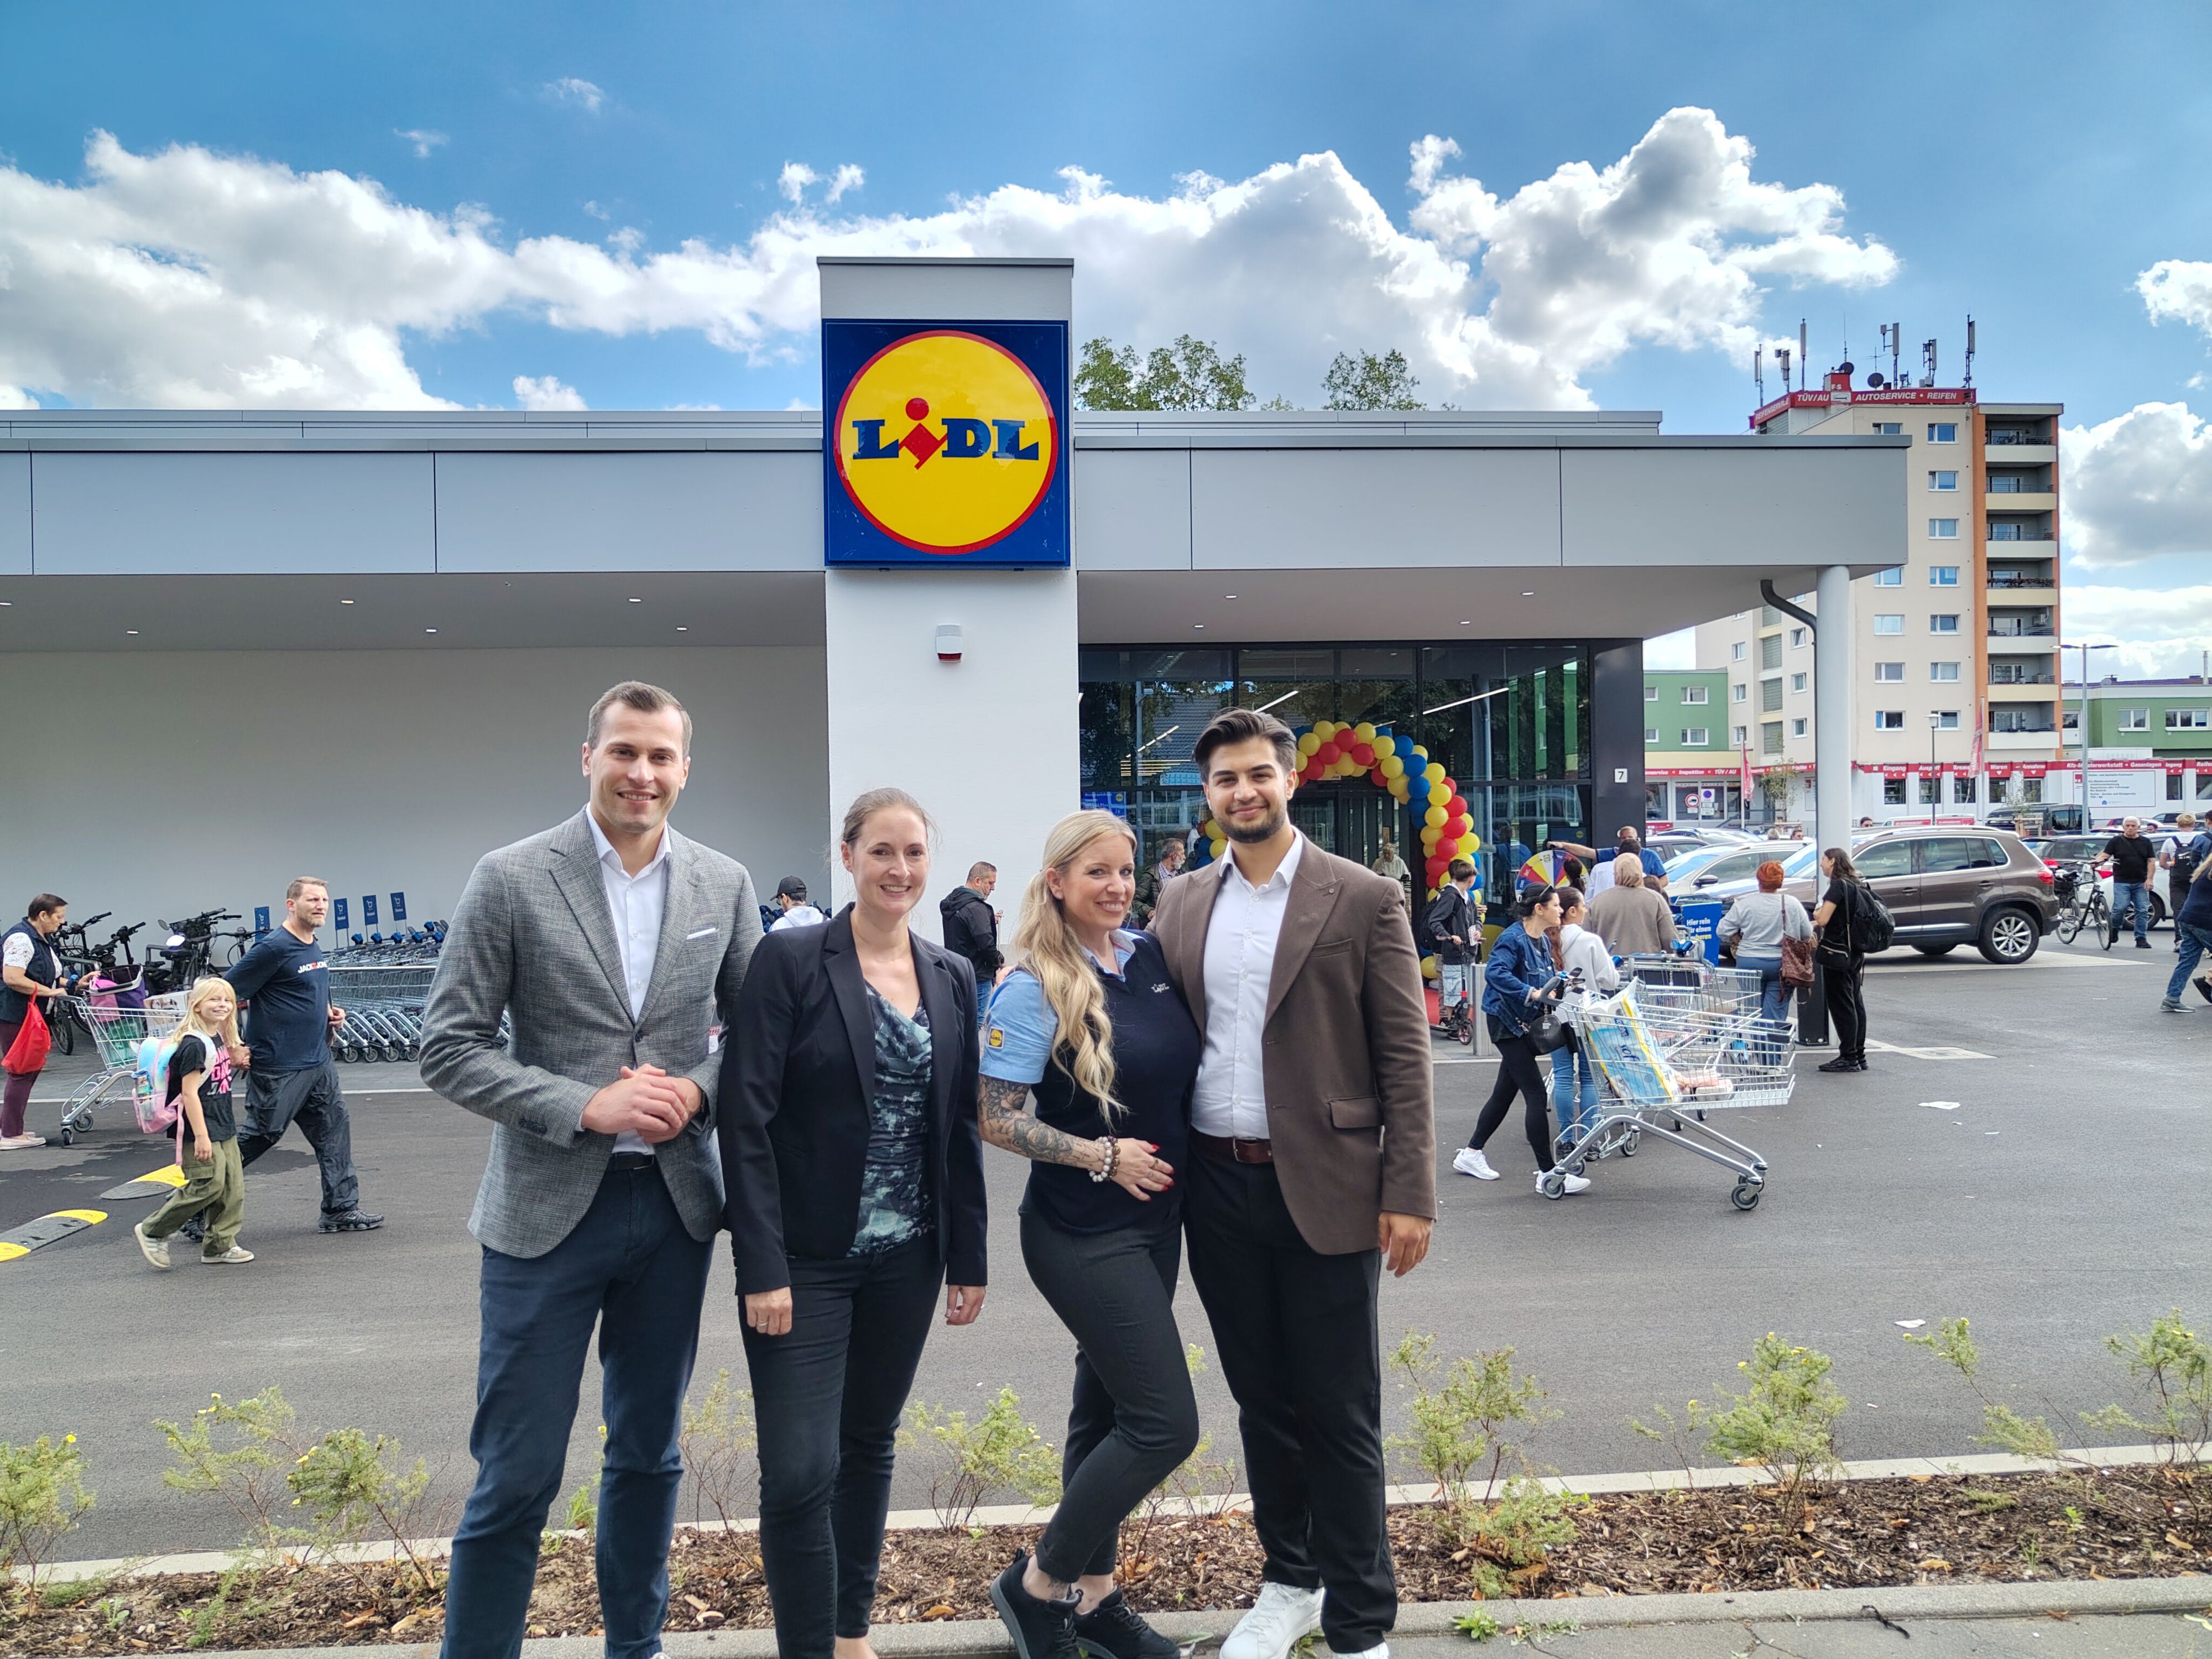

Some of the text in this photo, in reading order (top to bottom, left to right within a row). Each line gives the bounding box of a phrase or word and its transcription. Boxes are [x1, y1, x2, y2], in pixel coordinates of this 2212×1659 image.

[1855, 392, 1916, 401] AUTOSERVICE
[1755, 398, 1790, 421] REIFENSERVICE
[1618, 771, 1624, 780] 7
